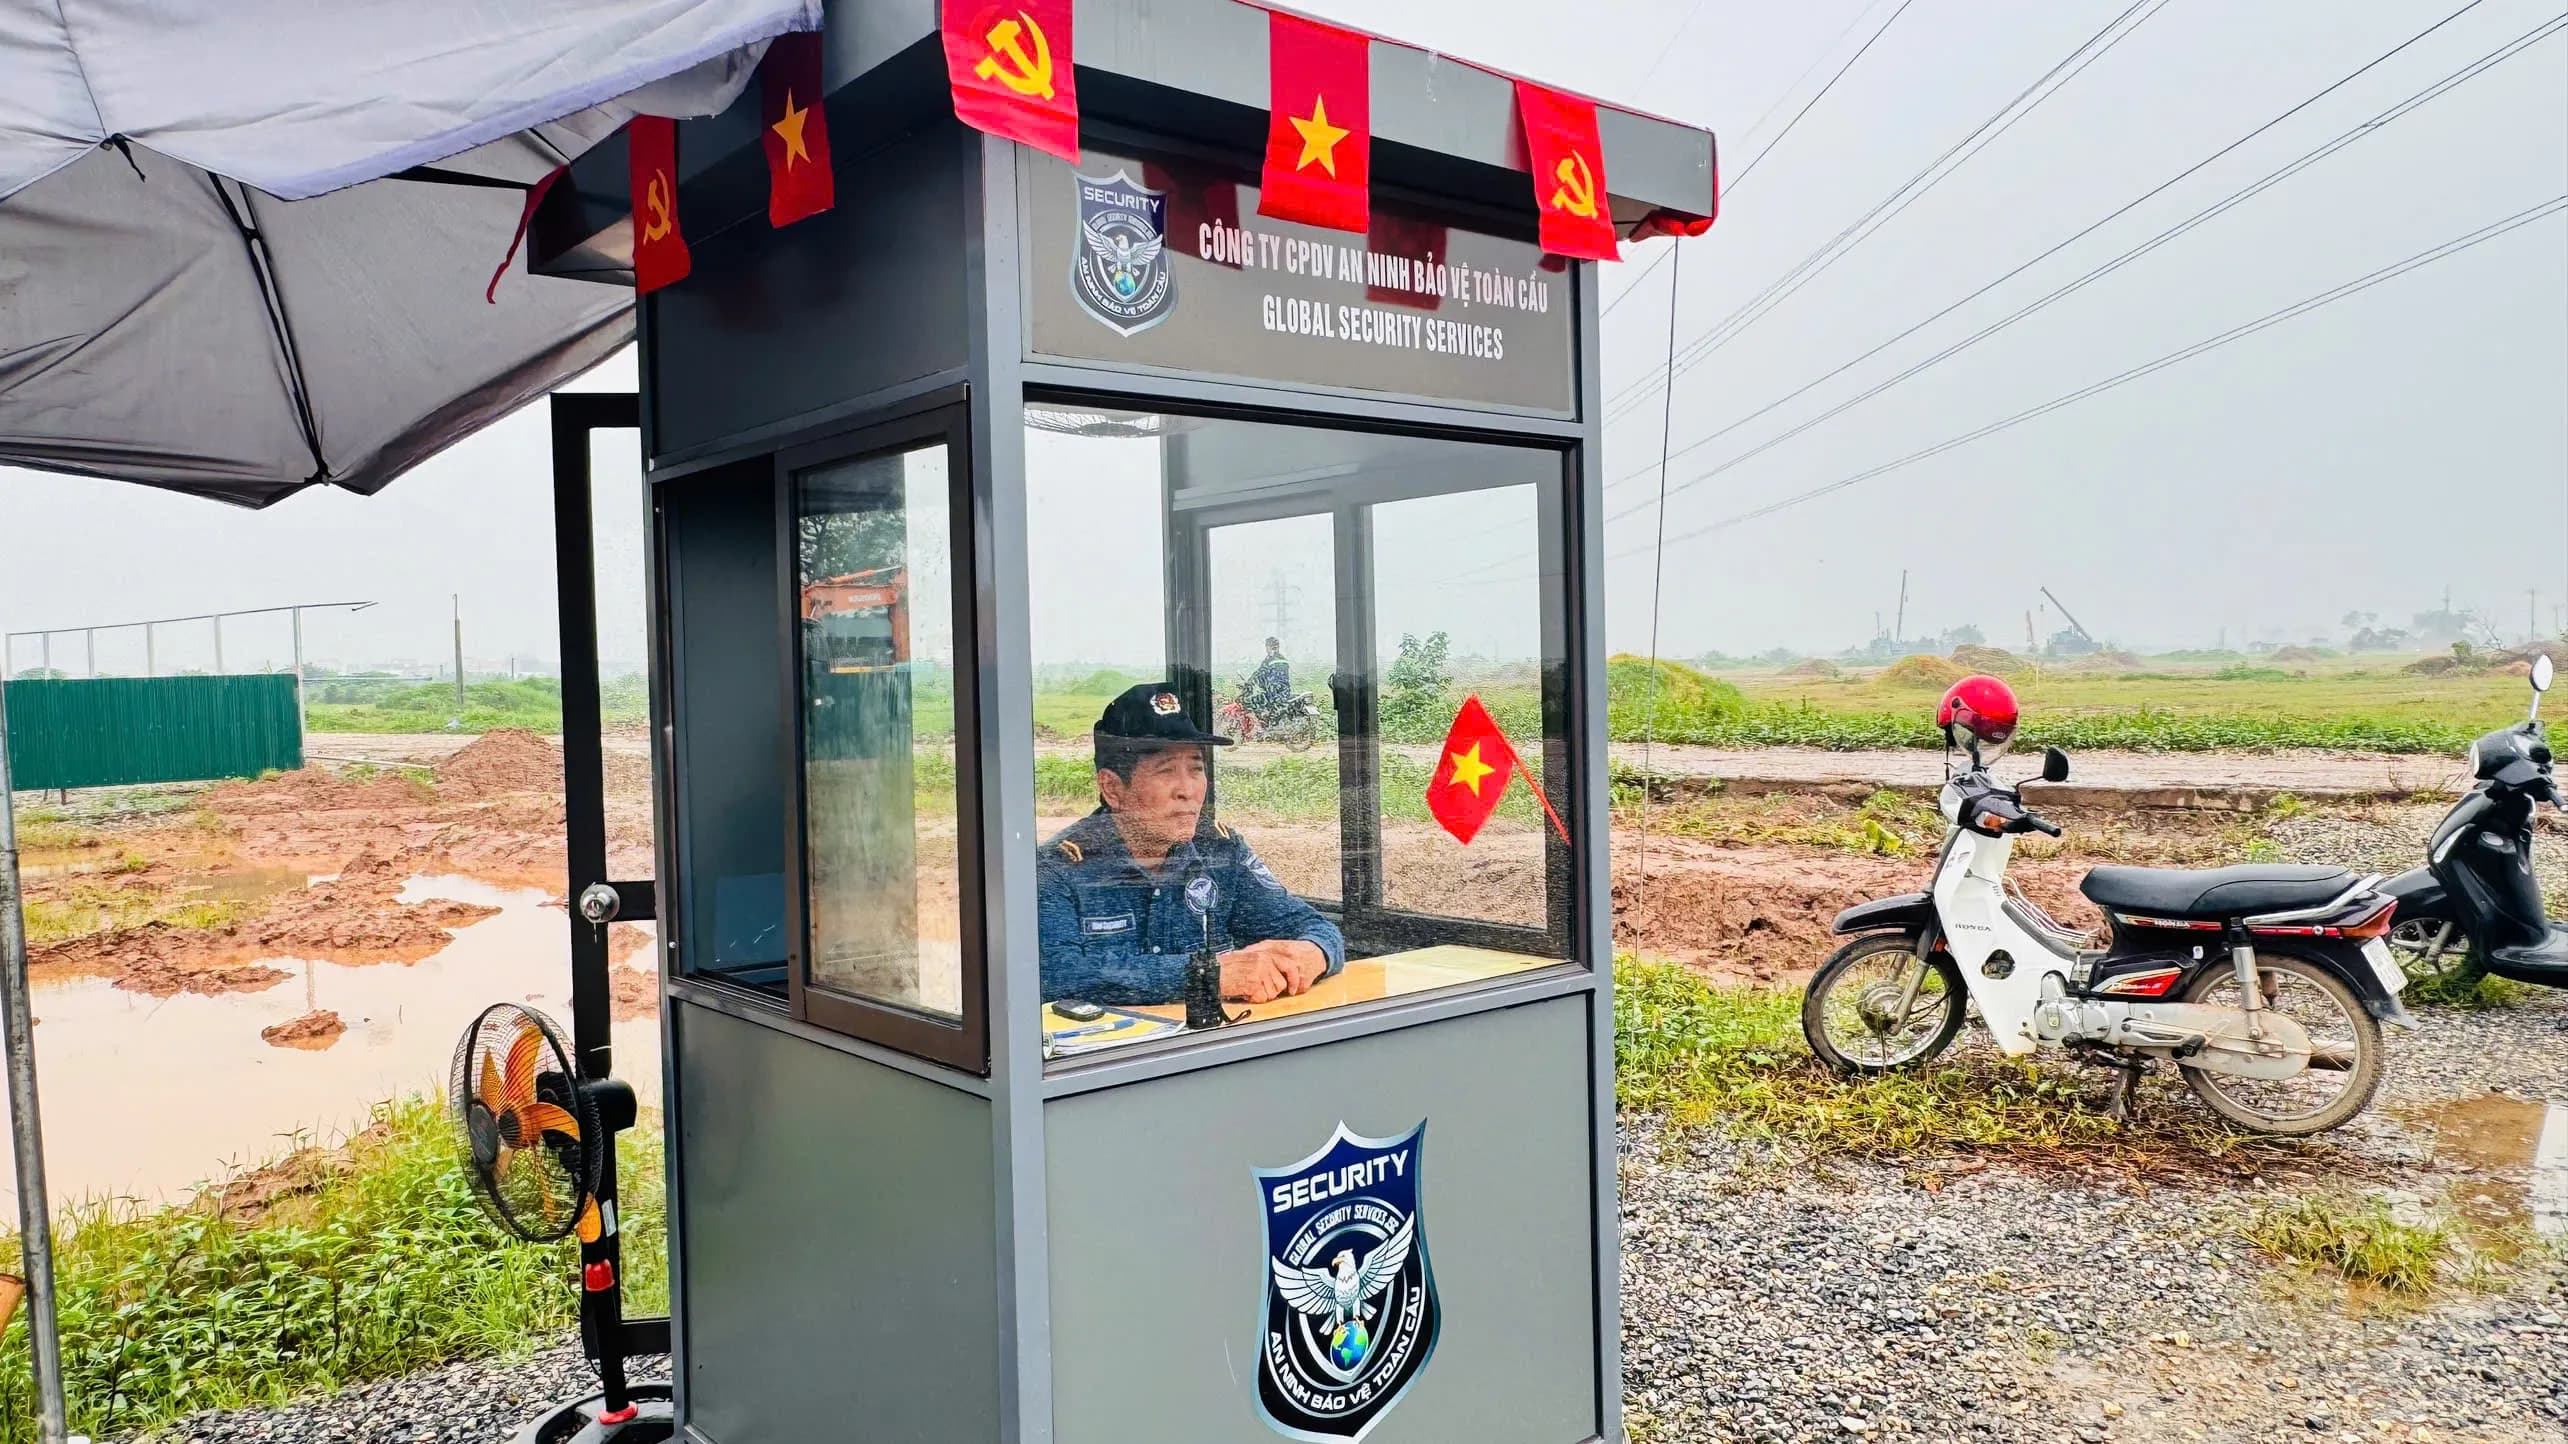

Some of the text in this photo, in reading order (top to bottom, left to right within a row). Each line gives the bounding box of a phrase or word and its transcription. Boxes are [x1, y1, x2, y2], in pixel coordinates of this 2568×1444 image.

[1084, 187, 1159, 214] SECURITY
[1199, 218, 1254, 267] CÔNG
[1258, 233, 1281, 271] TY
[1286, 238, 1334, 279] CPDV
[1338, 247, 1363, 283] AN
[1367, 252, 1410, 291] NINH
[1414, 251, 1447, 297] BẢO
[1451, 262, 1470, 308] VỆ
[1474, 267, 1515, 308] TOÀN
[1263, 294, 1504, 360] GLOBAL SECURITY SERVICES
[1272, 1149, 1409, 1213] SECURITY
[1315, 1205, 1352, 1236] SECURITY
[1270, 1331, 1286, 1365] AN
[1278, 1365, 1312, 1404] NINH
